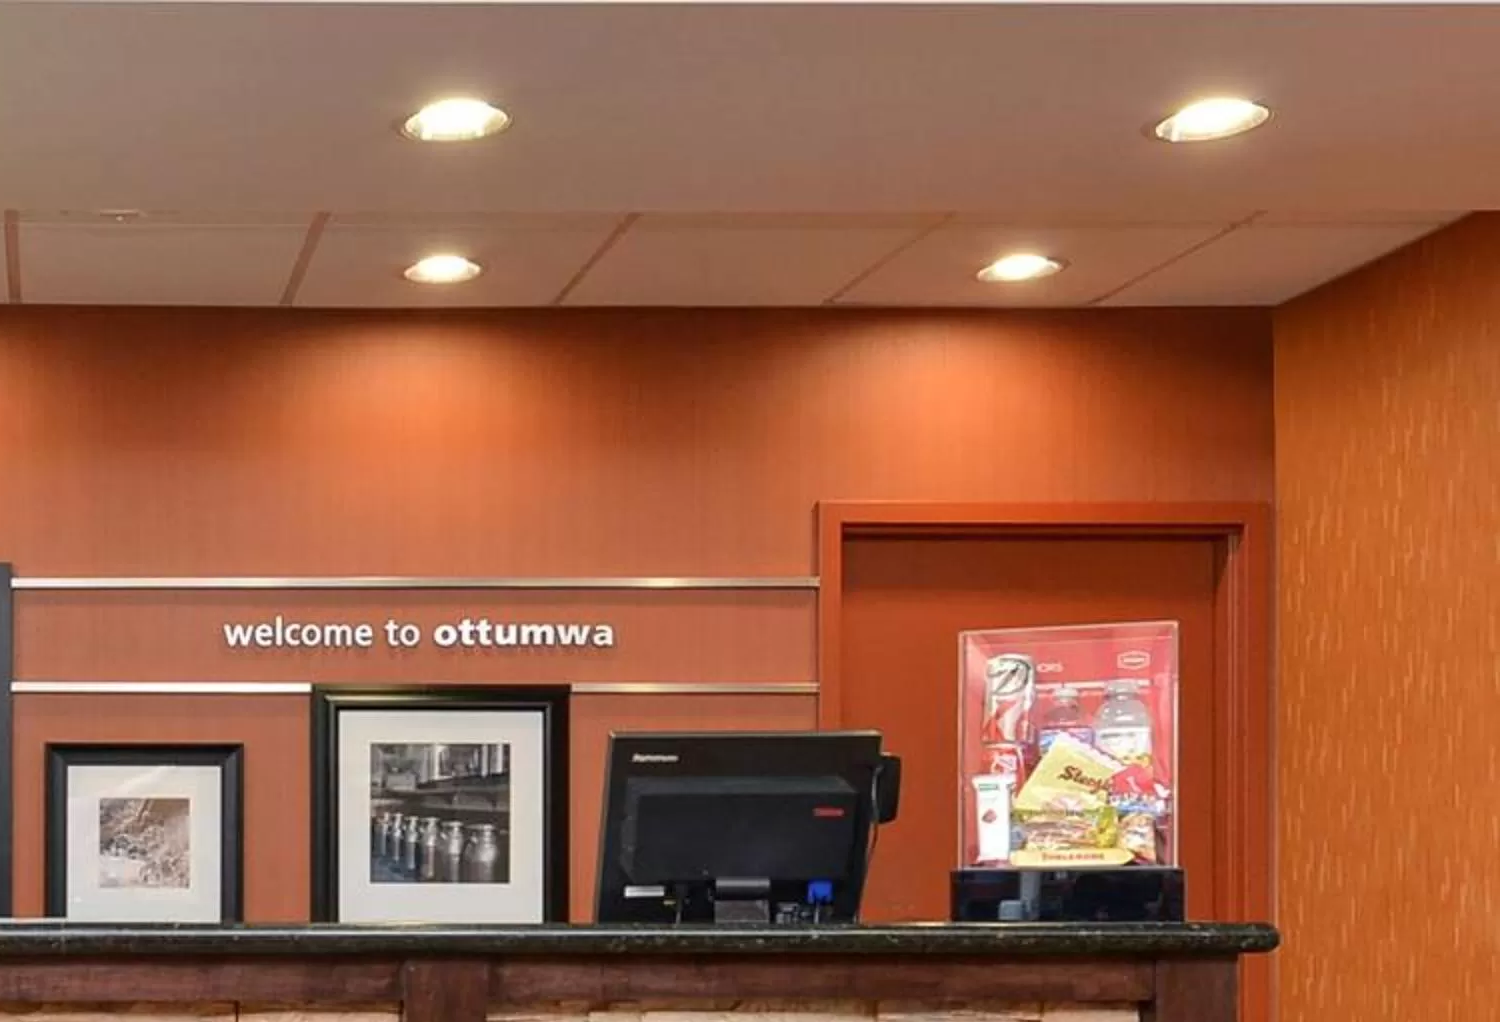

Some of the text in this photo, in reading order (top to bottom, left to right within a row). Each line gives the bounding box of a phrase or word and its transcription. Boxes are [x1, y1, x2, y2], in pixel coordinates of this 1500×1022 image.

[224, 616, 614, 647] welcome to ottumwa
